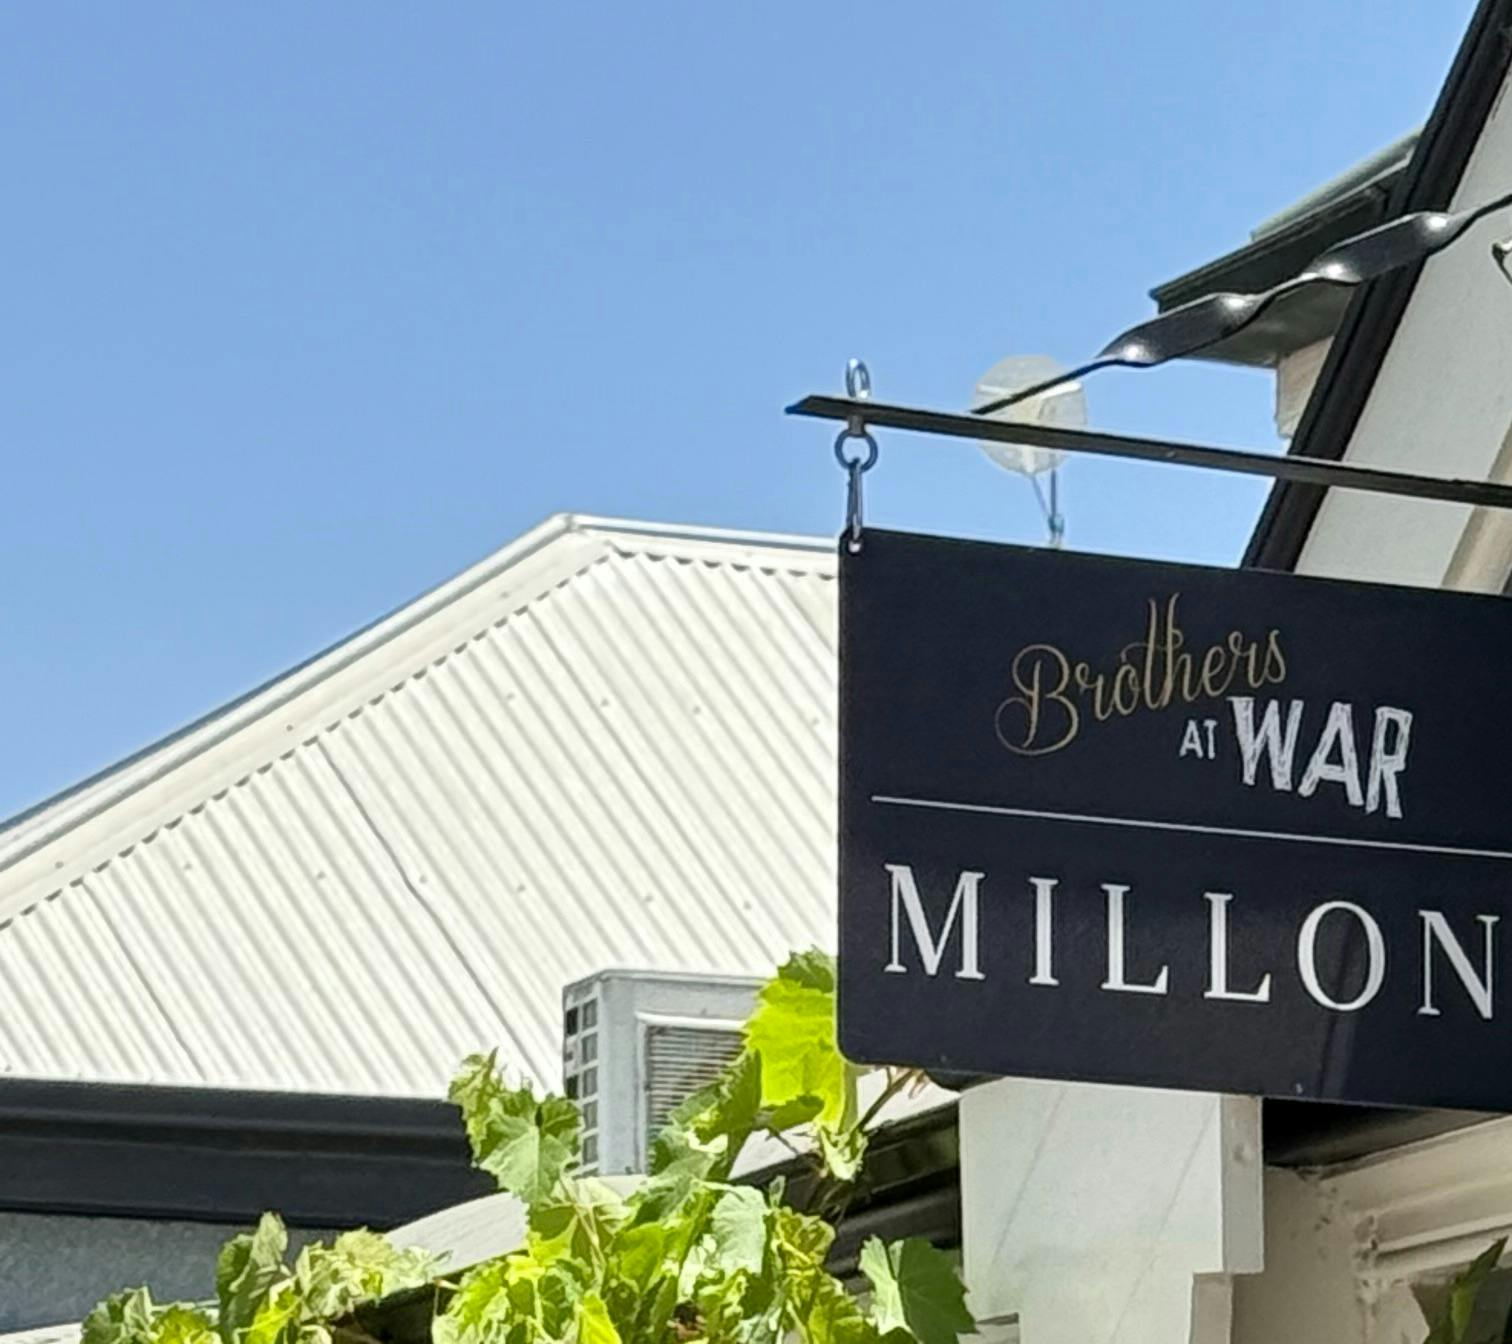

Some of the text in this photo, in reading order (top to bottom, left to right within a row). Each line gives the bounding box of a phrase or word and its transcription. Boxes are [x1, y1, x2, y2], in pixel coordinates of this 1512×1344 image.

[995, 593, 1286, 756] Brothers
[1180, 697, 1413, 818] AT WAR
[884, 864, 1499, 1019] MILLON
